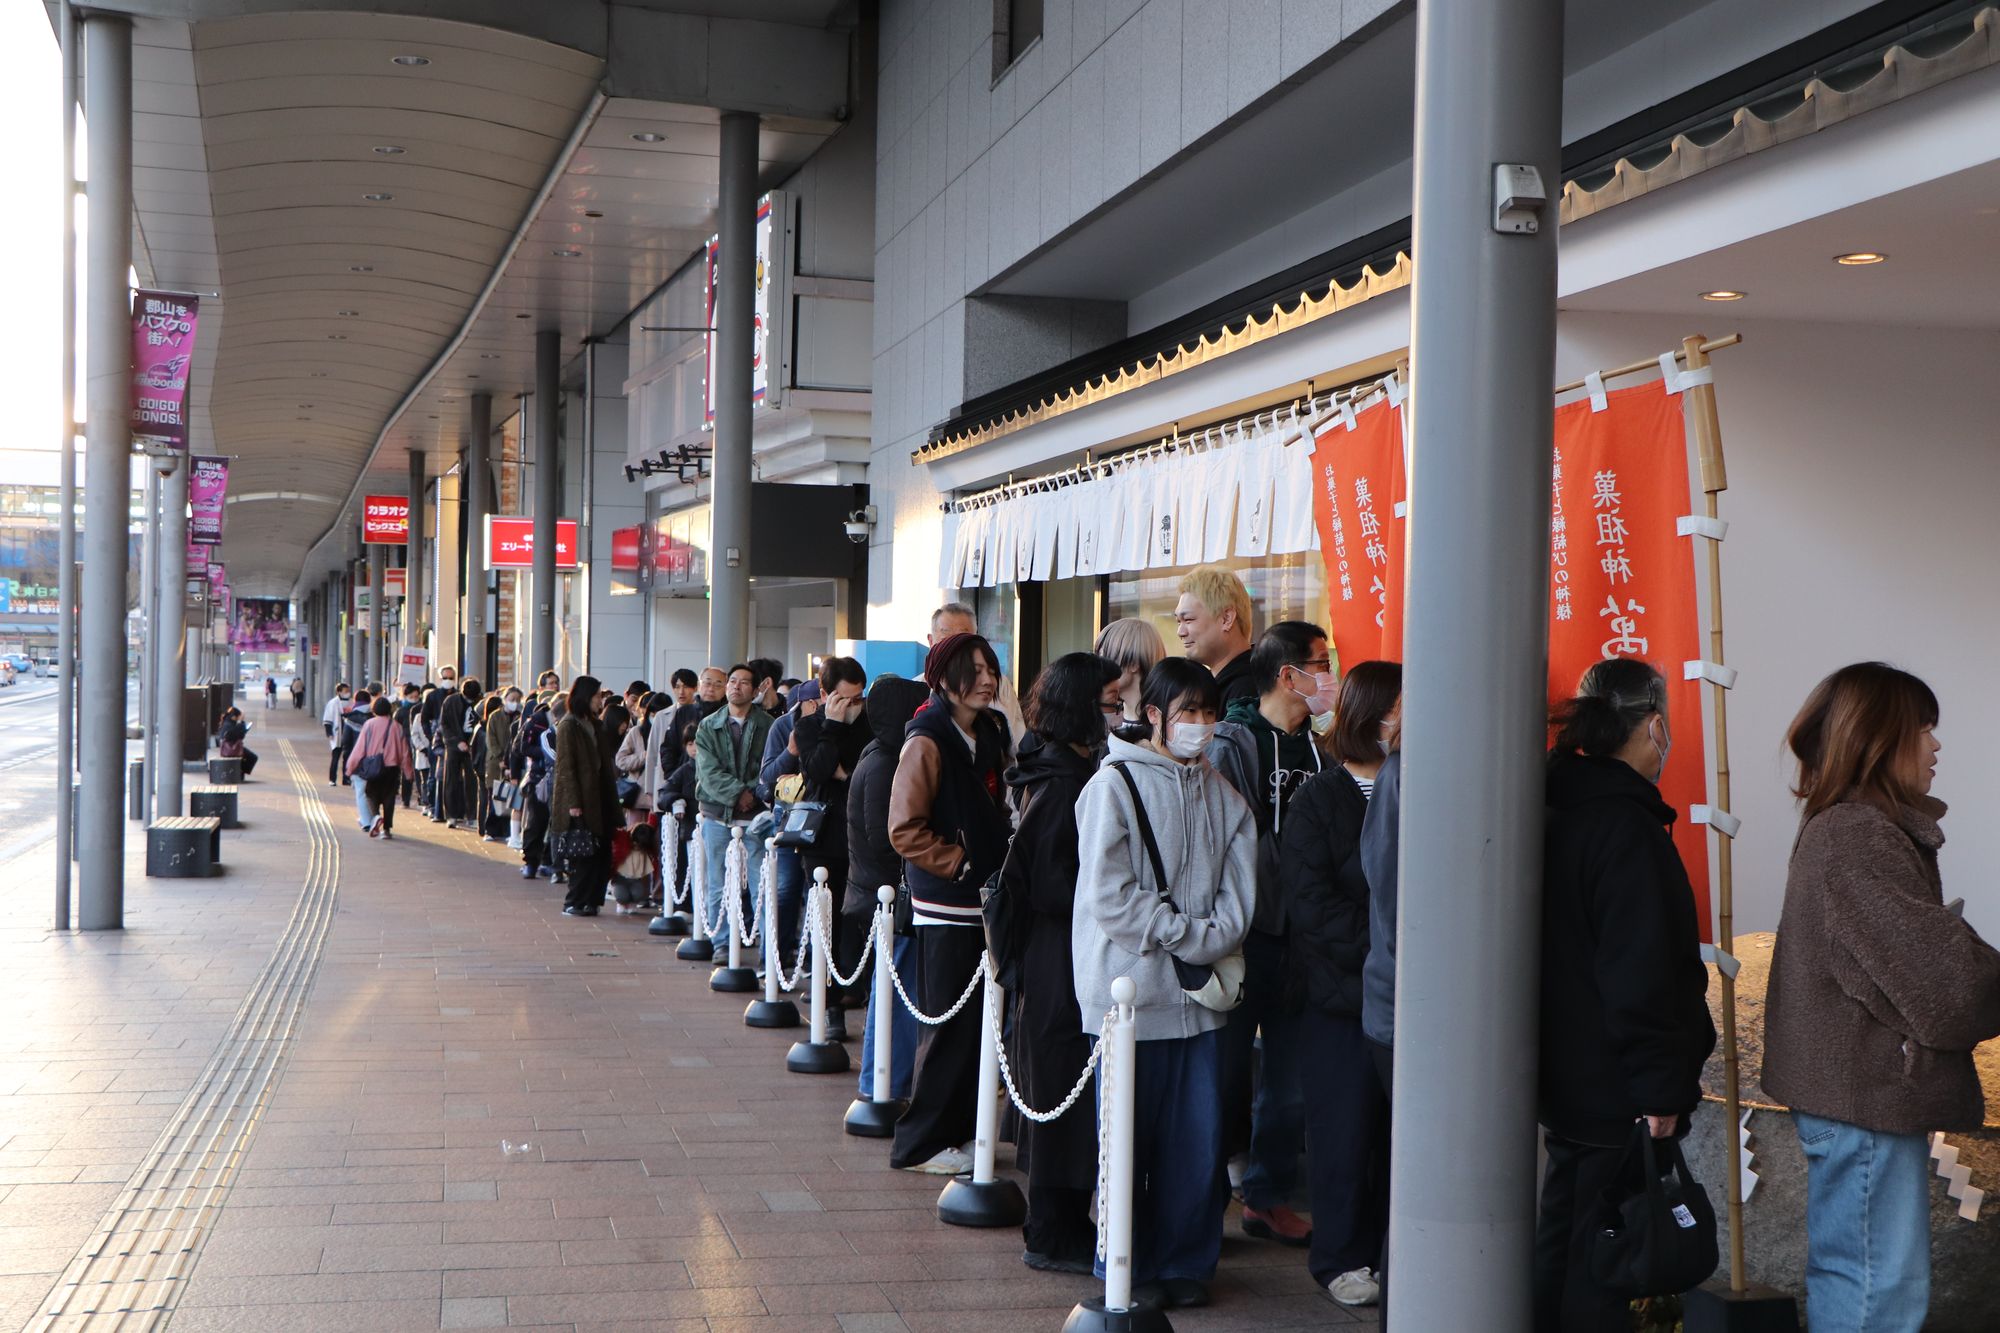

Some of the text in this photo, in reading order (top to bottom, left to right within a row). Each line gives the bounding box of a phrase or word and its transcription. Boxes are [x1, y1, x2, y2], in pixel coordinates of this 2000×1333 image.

[145, 299, 187, 317] 郡山を
[138, 314, 192, 333] バスケの
[367, 505, 409, 517] カラオケ
